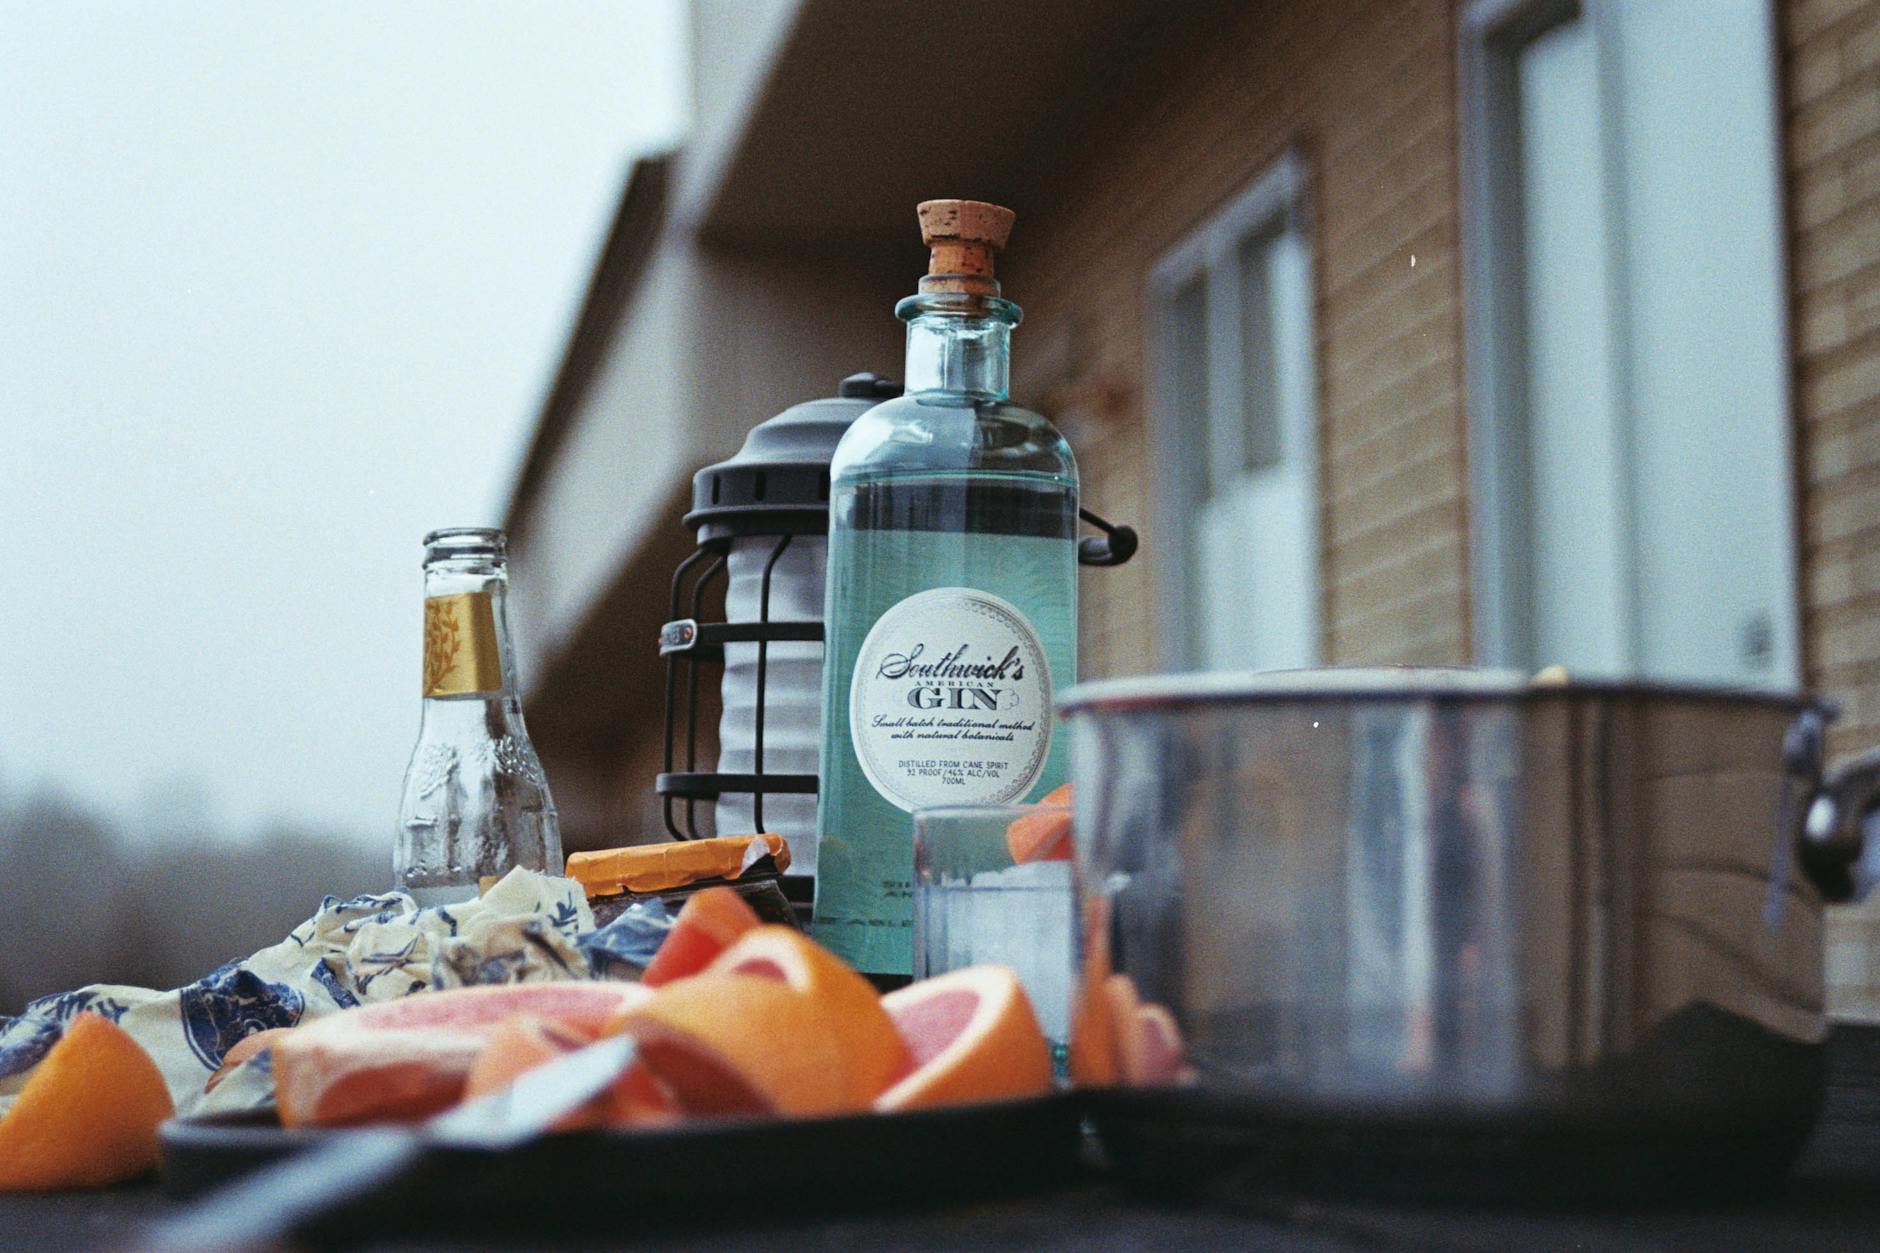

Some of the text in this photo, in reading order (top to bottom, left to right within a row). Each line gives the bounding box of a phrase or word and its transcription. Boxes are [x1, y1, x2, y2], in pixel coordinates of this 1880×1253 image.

[876, 643, 1024, 680] Southwick's
[914, 680, 995, 688] AMERICAN
[907, 687, 1002, 710] GIN
[872, 714, 1035, 730] Small batch traditional method
[890, 729, 1014, 741] with natural botanicals
[898, 760, 1009, 770] DISTILLED FROM CANE SPIRIT
[967, 770, 1001, 779] ALC/VOL
[942, 777, 966, 785] 700ML
